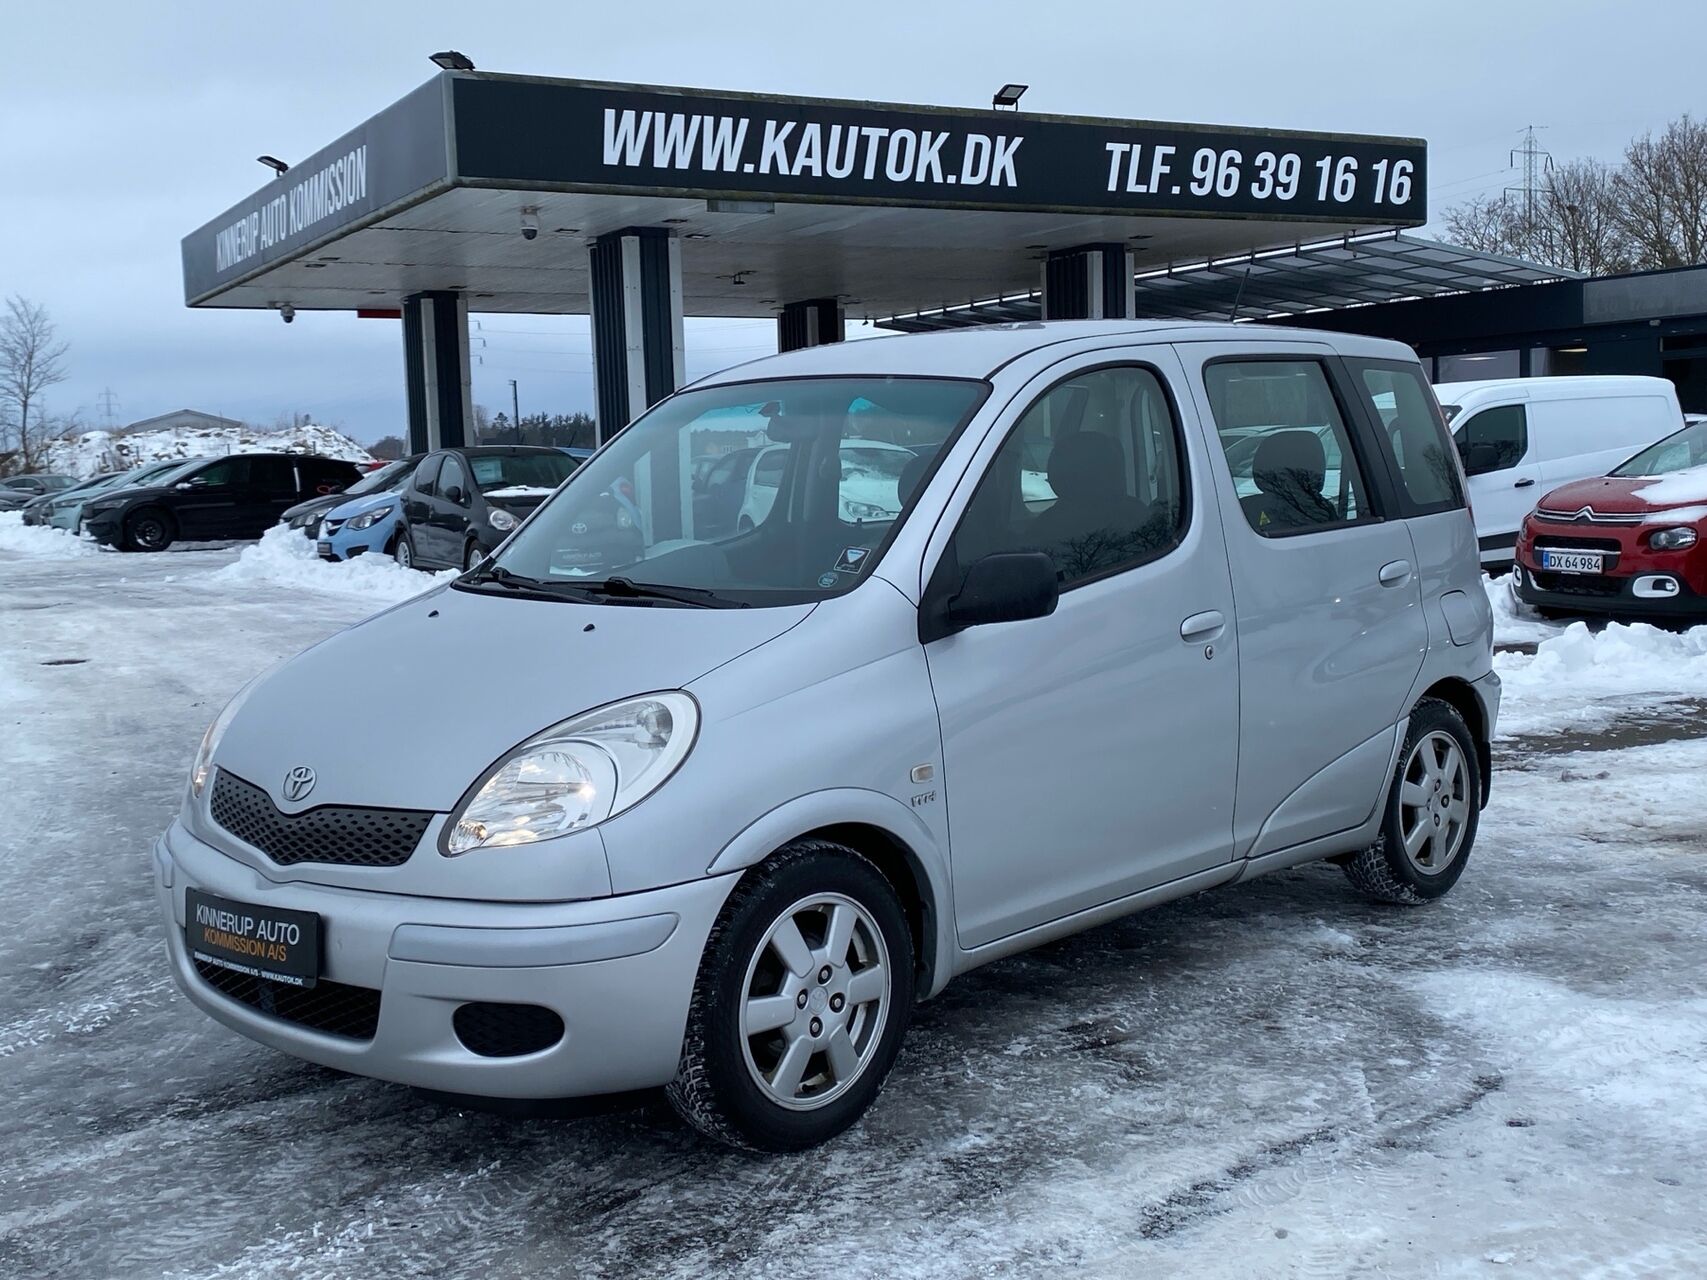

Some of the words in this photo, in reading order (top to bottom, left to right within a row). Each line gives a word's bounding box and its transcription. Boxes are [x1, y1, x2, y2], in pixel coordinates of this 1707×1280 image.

[602, 108, 1024, 188] WWW.KAUTOK.DK
[1105, 142, 1181, 195] TLF.
[1189, 147, 1243, 198] 96
[1250, 151, 1302, 201] 39
[1315, 155, 1359, 203] 16
[1372, 158, 1415, 206] 16
[216, 211, 259, 273] KINNERUP
[260, 194, 287, 250] AUTO
[289, 145, 367, 236] KOMMISSION
[1549, 555, 1563, 568] DX
[1565, 556, 1578, 570] 64
[1580, 557, 1600, 571] 984
[196, 903, 254, 936] KINNERUP
[256, 919, 300, 946] AUTO
[204, 927, 265, 958] KOMMISSION
[267, 944, 287, 962] A/S
